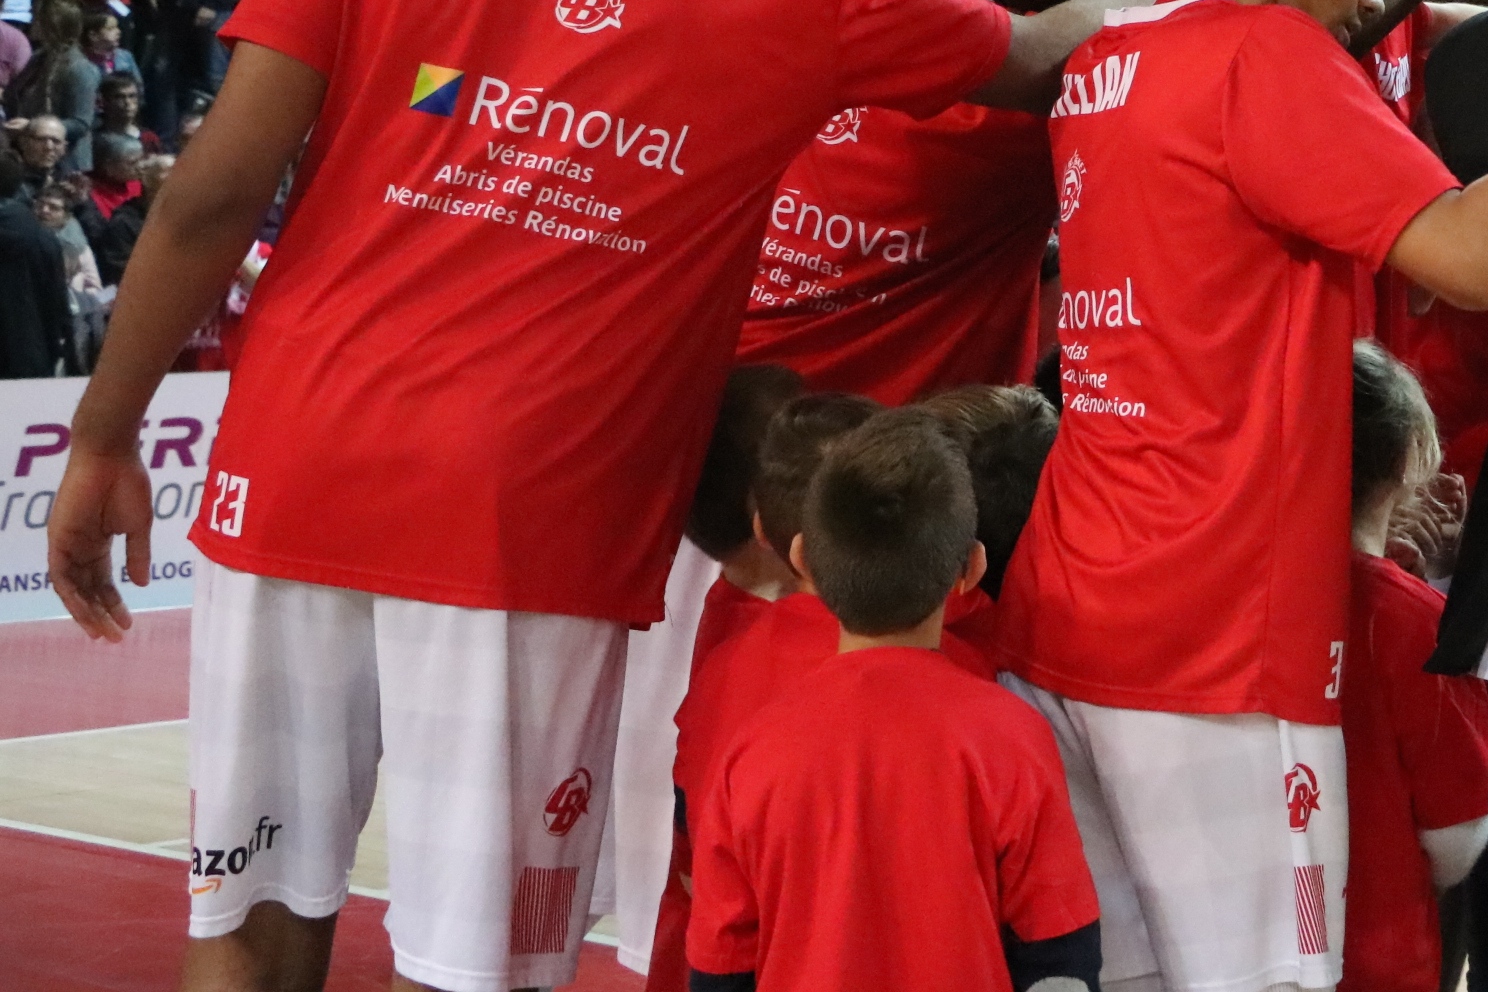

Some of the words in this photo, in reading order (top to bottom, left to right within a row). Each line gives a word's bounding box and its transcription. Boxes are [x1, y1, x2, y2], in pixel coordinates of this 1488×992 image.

[468, 75, 689, 176] Rénoval
[487, 141, 594, 183] Vérandas
[434, 165, 497, 192] Abris
[502, 175, 533, 198] de
[535, 186, 622, 222] piscine
[524, 210, 647, 254] Rénovtion
[771, 187, 930, 265] énoval
[1058, 277, 1142, 329] noval
[209, 469, 250, 538] 23
